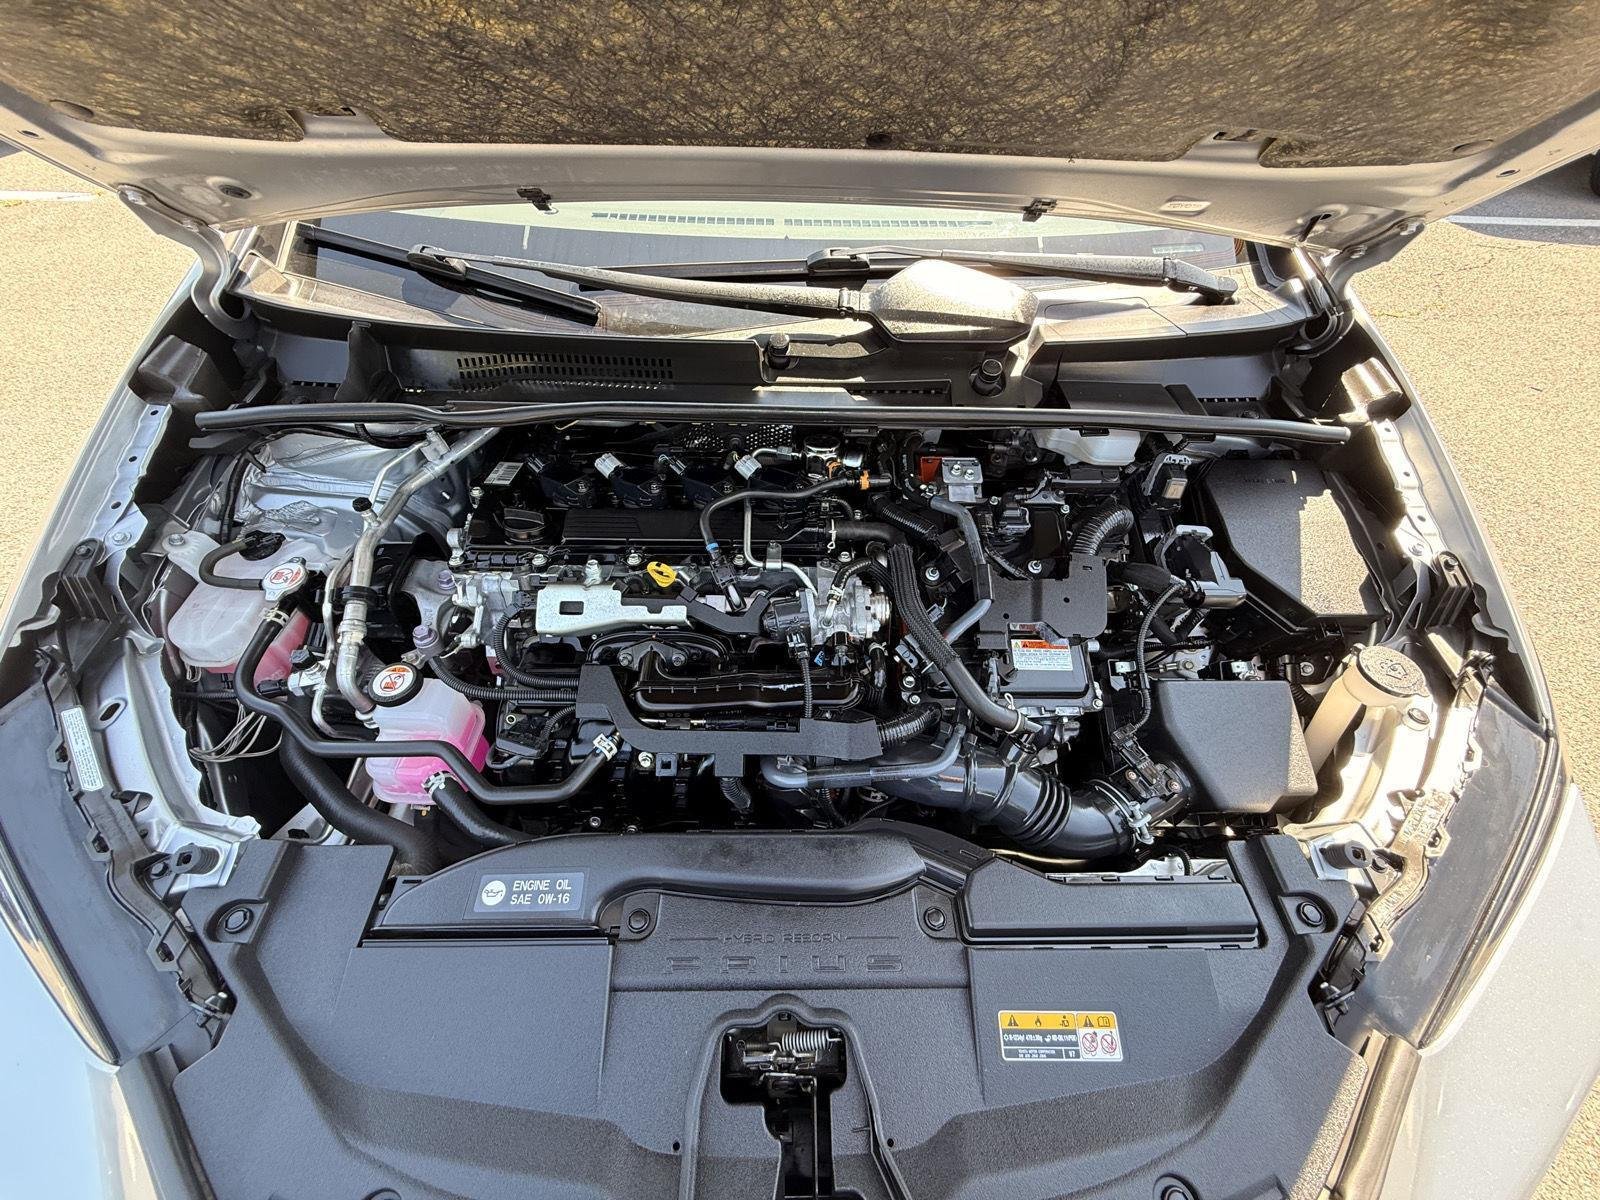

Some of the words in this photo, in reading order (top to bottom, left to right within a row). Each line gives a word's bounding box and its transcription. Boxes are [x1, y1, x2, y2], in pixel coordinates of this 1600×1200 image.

[512, 880, 551, 891] ENGINE
[556, 879, 572, 890] OIL
[510, 893, 532, 905] SAE
[537, 893, 570, 905] 0W-16
[723, 933, 775, 944] HYBRID
[782, 932, 842, 944] REBORN
[664, 955, 903, 975] PRIUS
